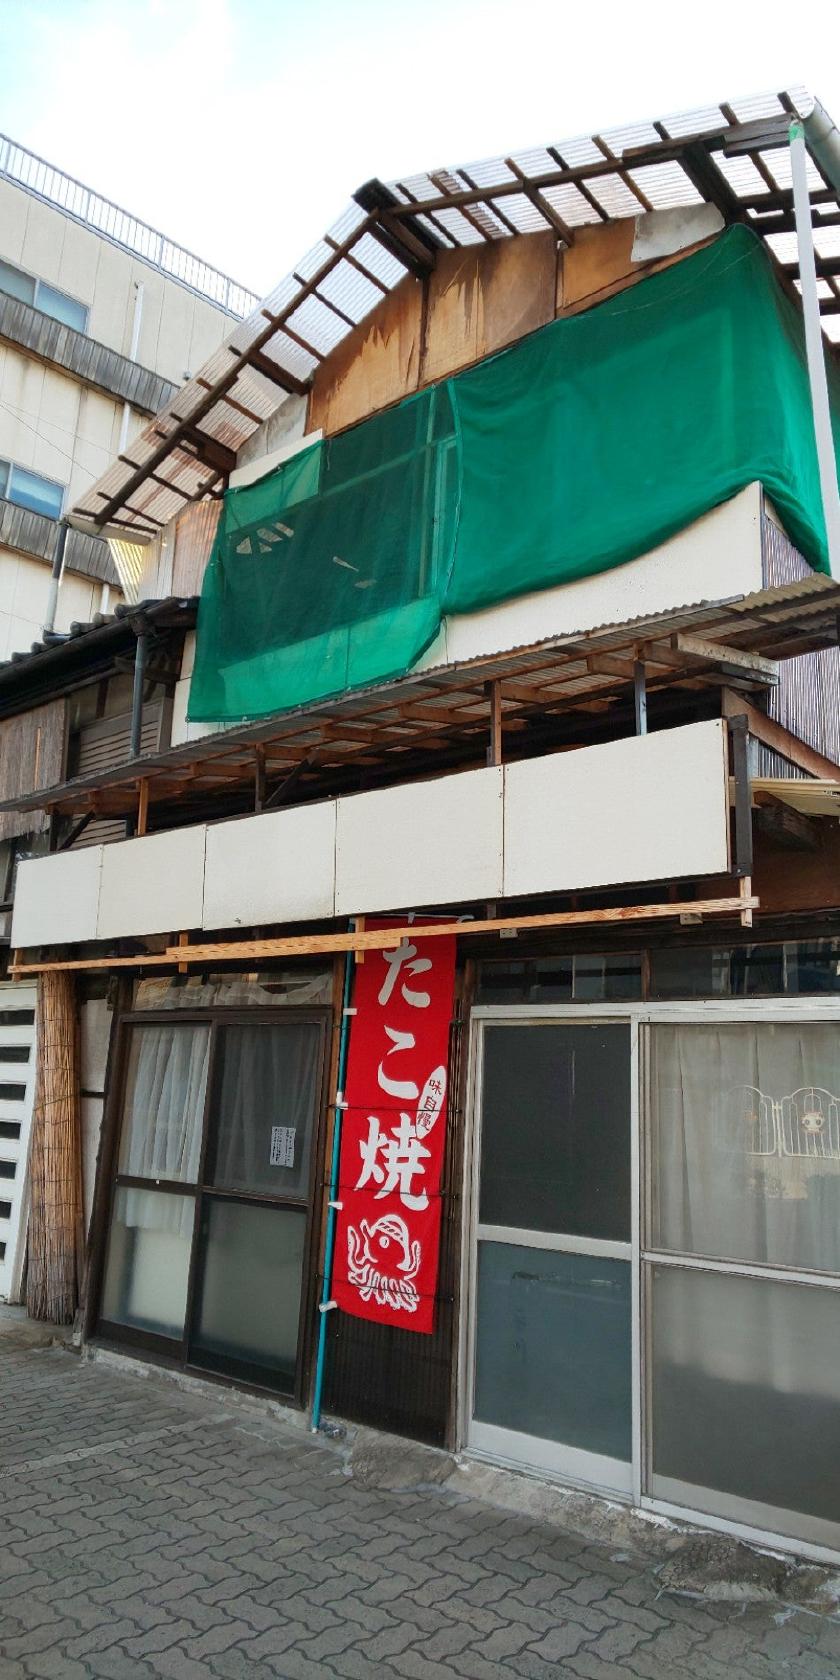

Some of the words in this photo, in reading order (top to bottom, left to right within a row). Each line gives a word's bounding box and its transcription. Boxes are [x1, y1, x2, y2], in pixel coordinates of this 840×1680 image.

[355, 939, 434, 1211] たこ焼
[417, 1079, 442, 1131] 味自慢
